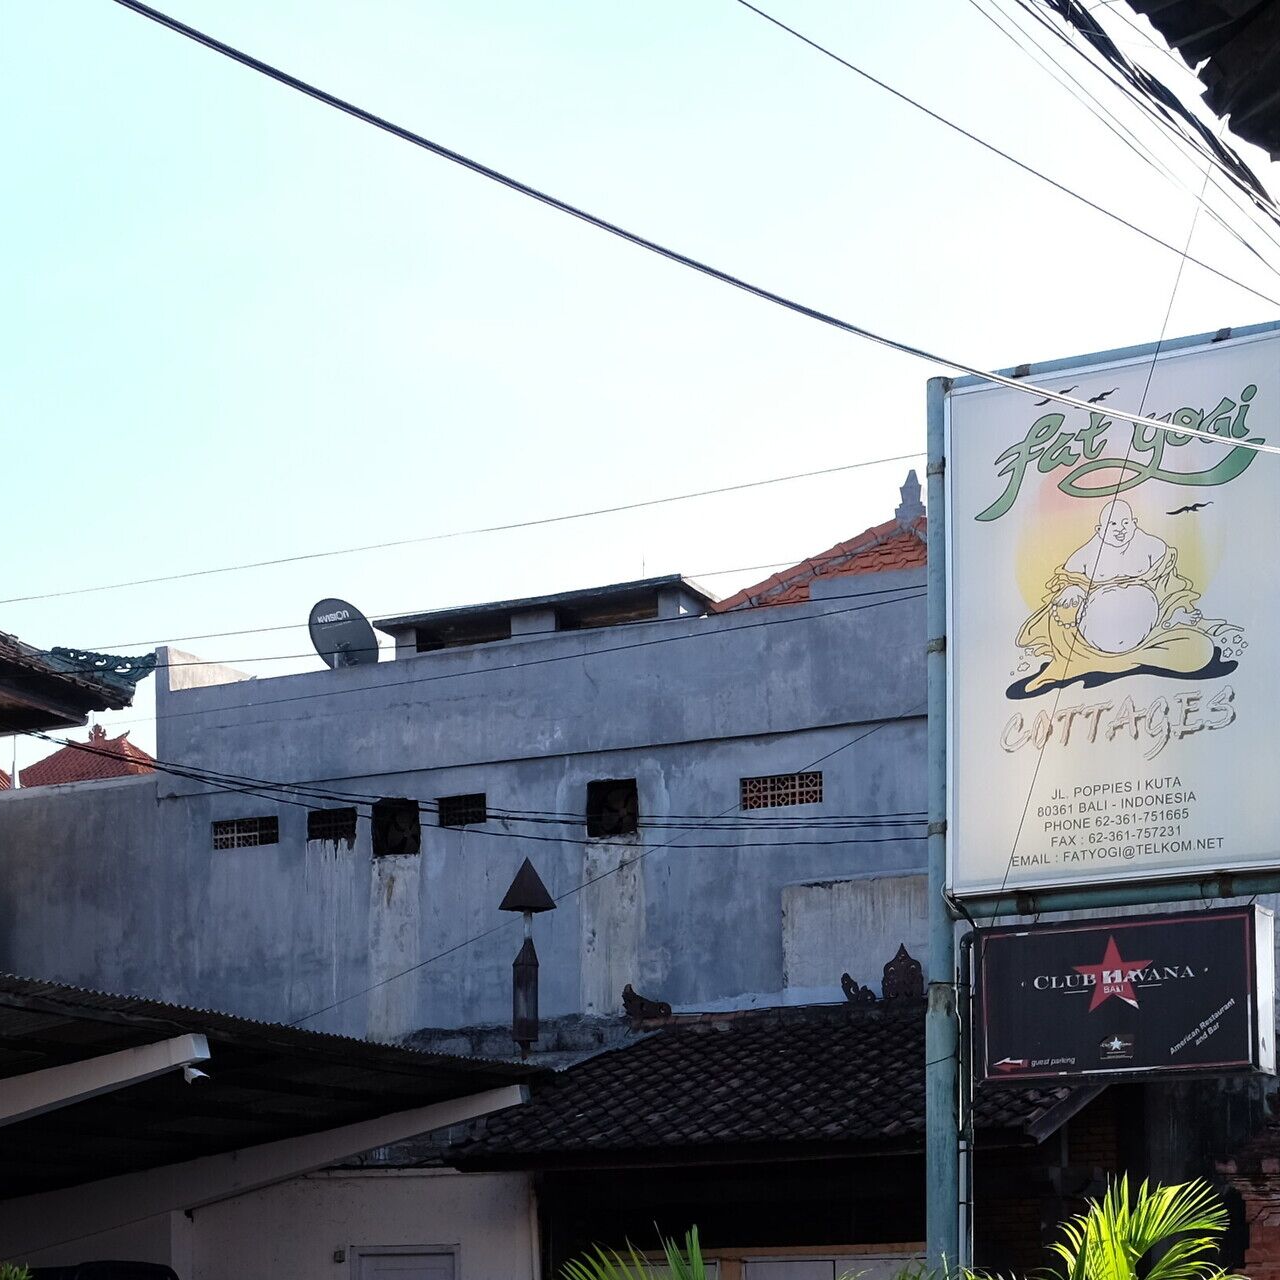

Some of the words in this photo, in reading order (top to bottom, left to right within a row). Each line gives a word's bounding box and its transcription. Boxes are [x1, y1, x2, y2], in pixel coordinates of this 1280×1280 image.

[999, 684, 1237, 761] COTTAGES
[1051, 788, 1070, 800] JL.
[1073, 781, 1133, 798] POPPIES
[1145, 776, 1181, 791] KUTA
[1037, 803, 1073, 817] 80361
[1078, 800, 1108, 813] BALI
[1121, 791, 1197, 810] INDONESIA
[1044, 817, 1090, 832] PHONE
[1095, 808, 1189, 828] 62-361-751665
[1051, 836, 1076, 848] FAX
[1088, 825, 1181, 844] 62-361-757231
[1012, 854, 1051, 868] EMAIL
[1063, 837, 1224, 863] FATYOGI@TELKOM.NET
[1034, 974, 1097, 990] CLUB
[1103, 965, 1195, 985] HAVANA
[1170, 1028, 1200, 1055] American
[1199, 998, 1236, 1029] Restaurant
[1195, 1034, 1208, 1047] and
